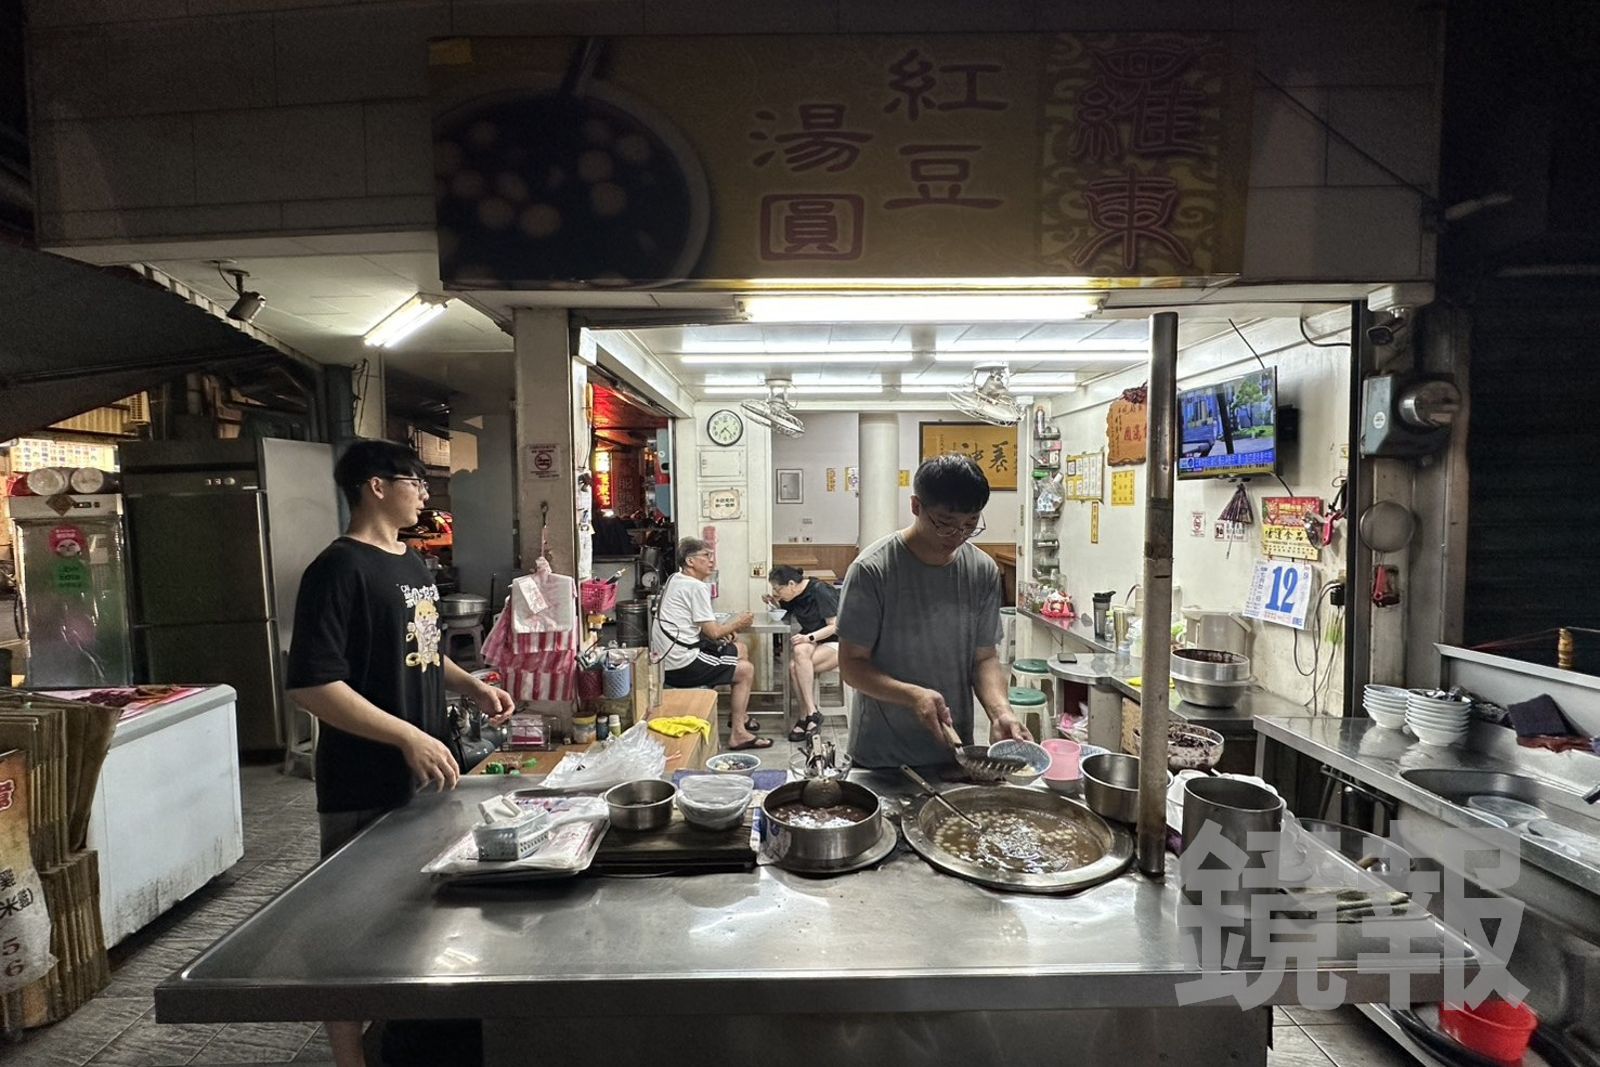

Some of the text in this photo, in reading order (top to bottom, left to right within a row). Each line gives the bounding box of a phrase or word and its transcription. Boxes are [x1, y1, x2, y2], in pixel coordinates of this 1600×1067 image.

[749, 103, 874, 262] 湯圓
[883, 48, 1009, 210] 紅豆
[1069, 45, 1206, 270] 羅東
[1264, 566, 1299, 614] 12
